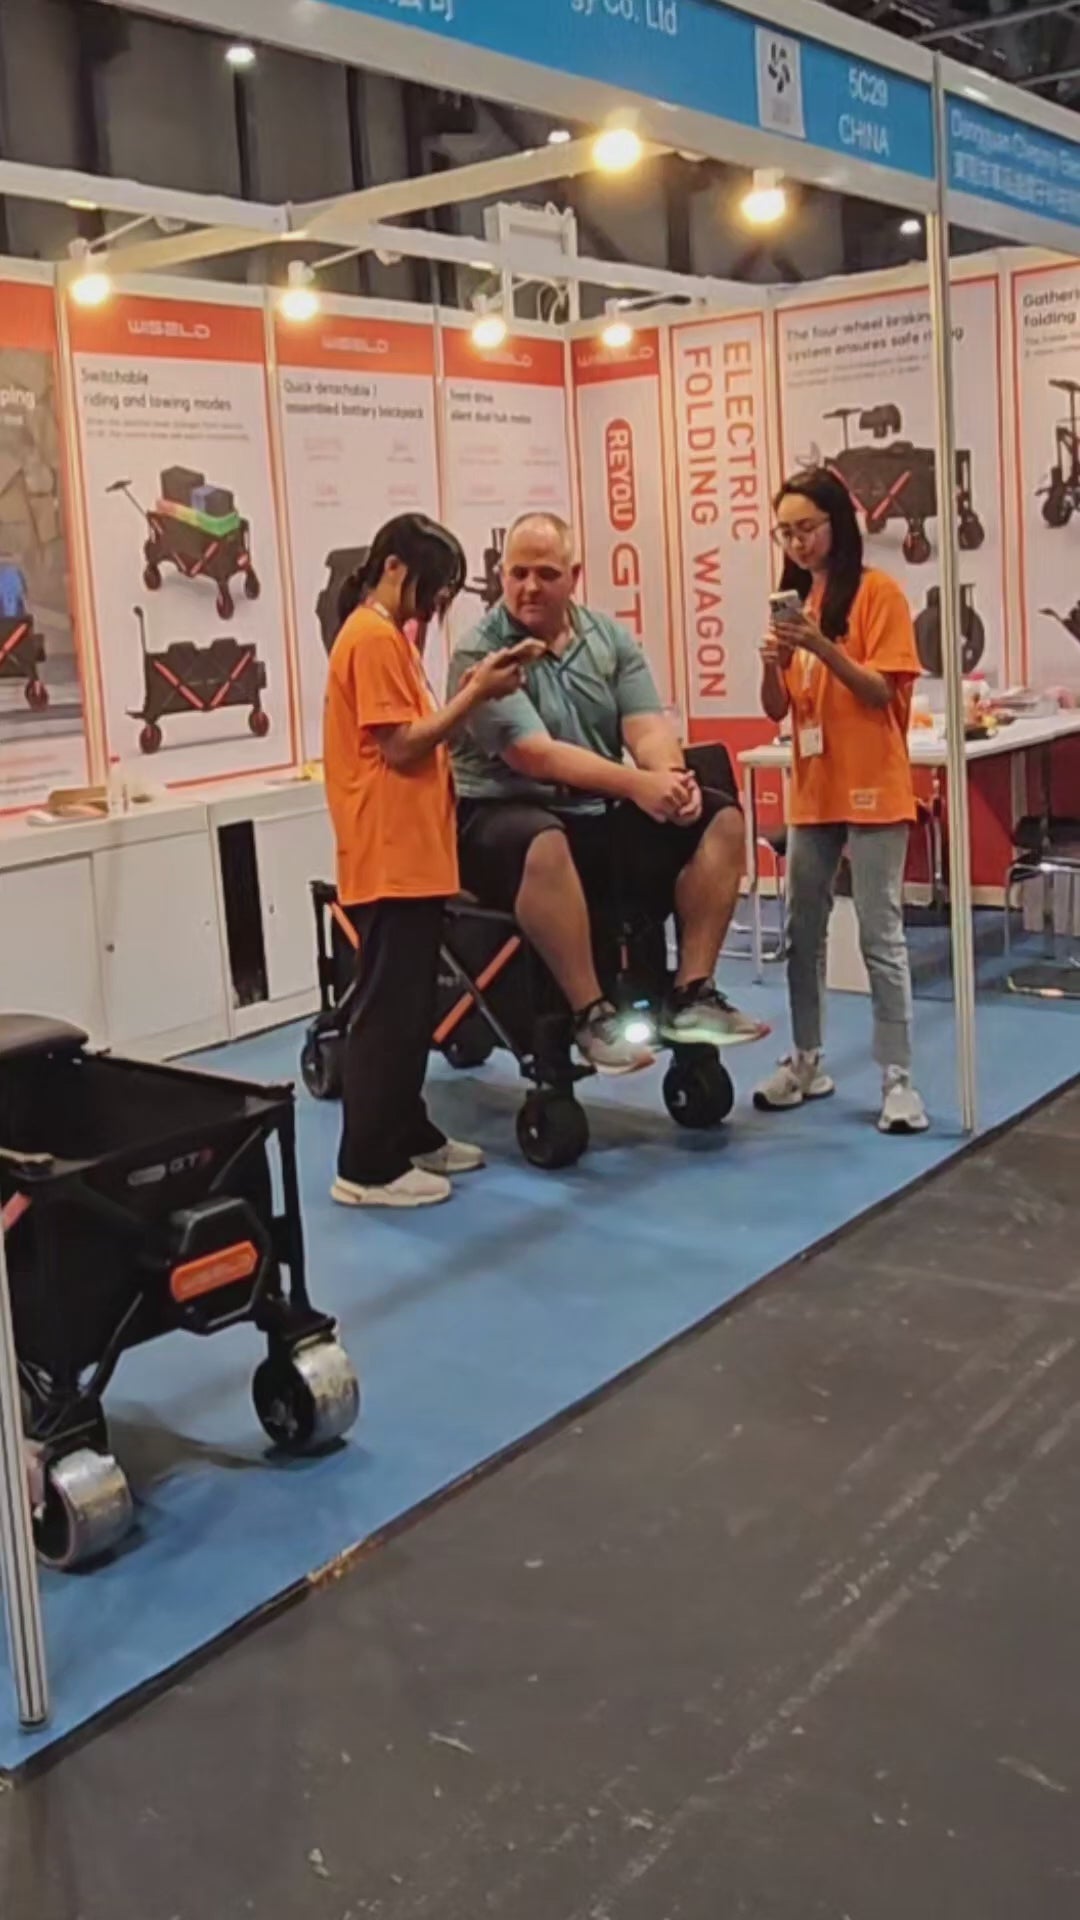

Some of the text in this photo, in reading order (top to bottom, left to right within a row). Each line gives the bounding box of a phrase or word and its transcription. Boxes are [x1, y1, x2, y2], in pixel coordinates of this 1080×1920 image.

[848, 69, 888, 108] 5C29
[838, 114, 890, 156] CHINA
[1022, 288, 1080, 308] Gatheri
[886, 310, 932, 328] brakin
[1024, 311, 1077, 328] folding
[835, 338, 888, 355] ensures
[891, 331, 920, 347] safe
[0, 384, 36, 411] ping
[84, 392, 232, 412] riding and towing modes
[723, 340, 760, 543] ELECTRIC
[606, 428, 635, 524] REYOU
[683, 345, 727, 698] FOLDING WAGON
[611, 542, 643, 640] GT
